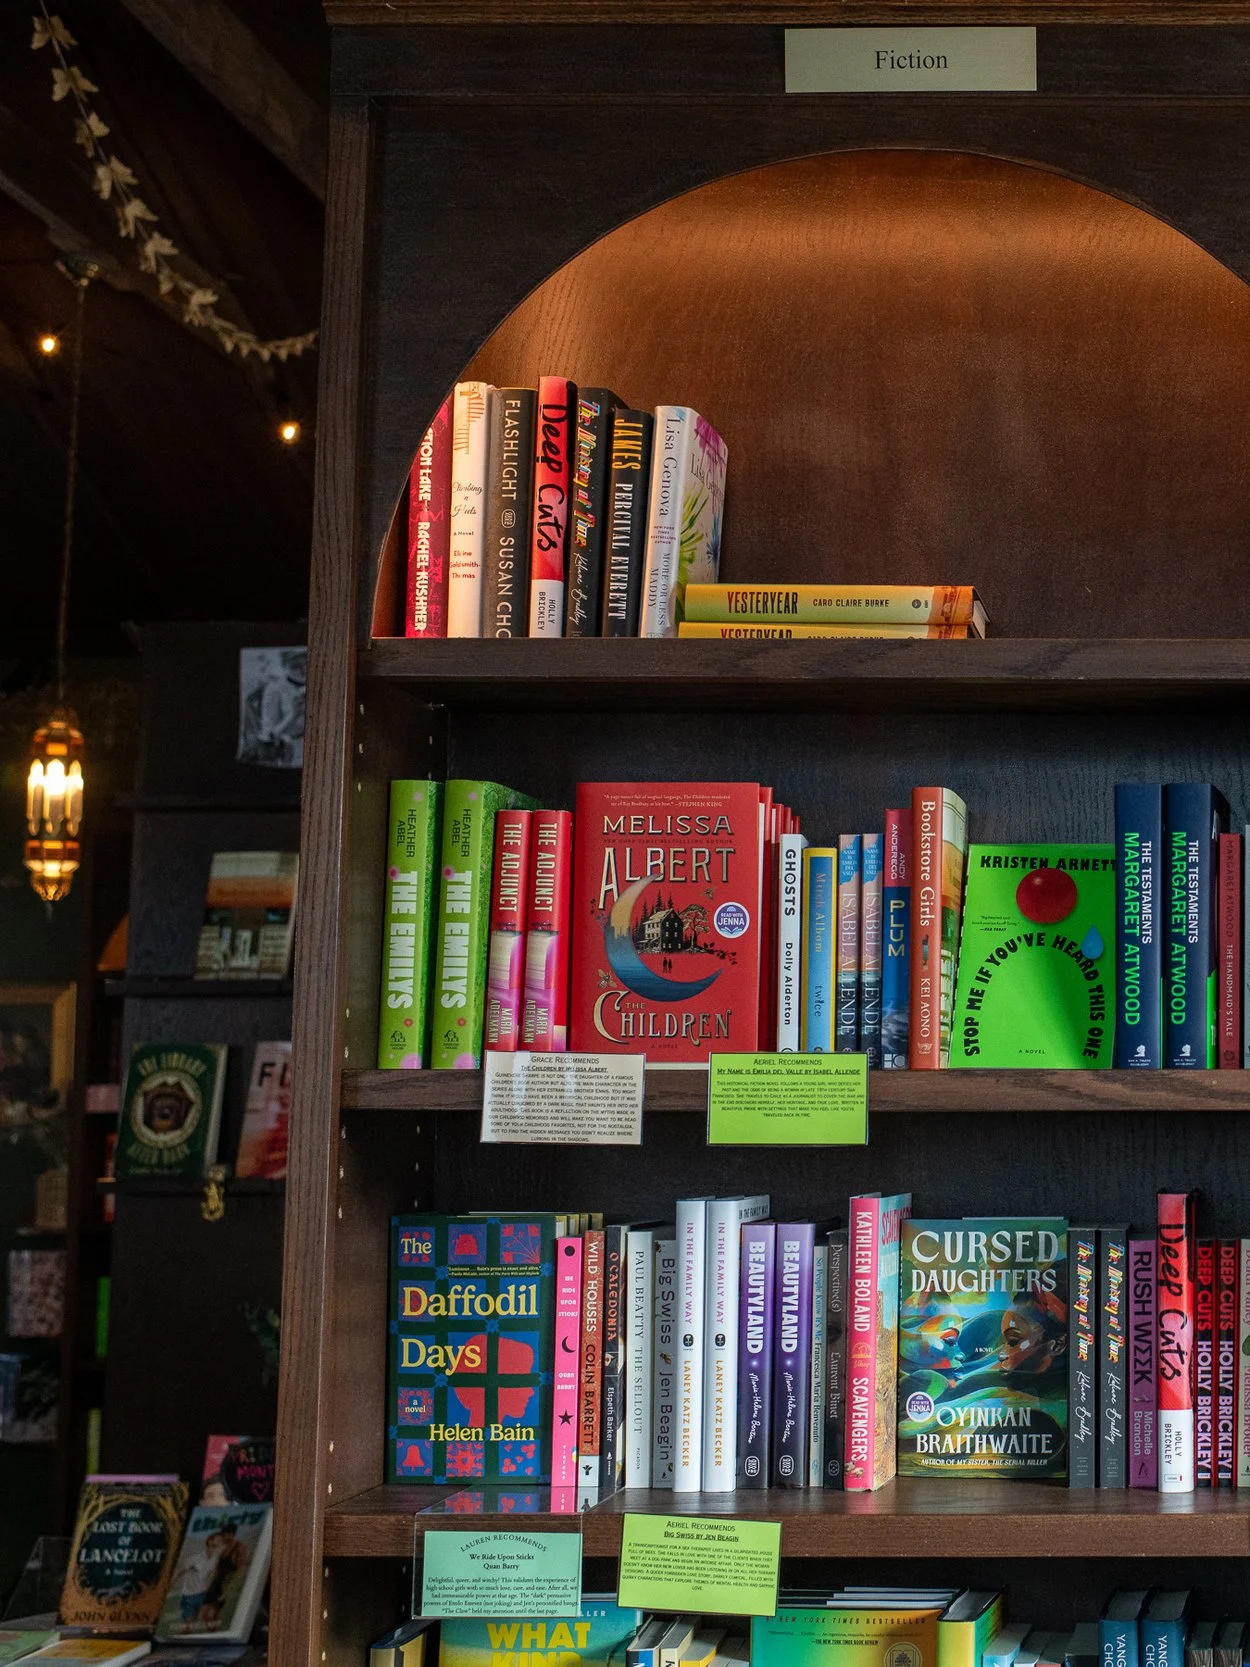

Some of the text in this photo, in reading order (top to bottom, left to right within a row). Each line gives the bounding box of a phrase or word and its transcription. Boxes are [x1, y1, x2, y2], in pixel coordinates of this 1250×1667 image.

[874, 50, 948, 69] Fiction
[501, 400, 522, 502] FLASHLIGHT
[613, 418, 644, 471] JAMES
[536, 404, 568, 552] Deep Cuts
[497, 537, 515, 597] SUSAN
[608, 483, 633, 620] PERCIVAL EVERETT
[538, 591, 547, 631] BRICKLEY
[547, 598, 555, 624] HOLLY
[727, 591, 798, 616] YESTERYEAR
[813, 597, 890, 608] CARO CLAIRE BURKE
[396, 819, 405, 846] ABEL
[407, 808, 416, 858] HEATHER
[603, 816, 734, 835] MELISSA
[499, 823, 521, 913] THE ADJUNCT
[599, 847, 736, 910] ALBERT
[784, 848, 796, 917] GHOSTS
[920, 800, 935, 927] Bookstore Girls
[980, 856, 1049, 869] KRISTEN
[1141, 841, 1152, 944] THE TESTAMENTS
[387, 871, 418, 1009] THE EMILYS
[717, 917, 745, 926] JENNA
[1124, 832, 1139, 1025] MARGARET ATWOOD
[784, 942, 793, 1026] Dolly Alderton
[964, 932, 1105, 1060] STOP ME IF YOU'VE HEARD THIS ONE
[488, 999, 500, 1043] ADELMANN
[499, 1008, 513, 1034] MARIA
[593, 990, 732, 1045] CHILDREN
[401, 1238, 432, 1254] The
[911, 1230, 1058, 1264] CURSED
[853, 1211, 873, 1332] KATHLEEN BOLAND
[911, 1269, 1058, 1293] DAUGHTERS
[1196, 1247, 1211, 1330] DEEP CUTS
[403, 1285, 539, 1317] Daffodil
[659, 1258, 675, 1344] Big Swiss
[746, 1242, 766, 1354] BEAUTYLAND
[401, 1338, 481, 1376] Days
[584, 1344, 596, 1447] COLIN BARRETT
[658, 1372, 673, 1460] Jen Beagin
[936, 1406, 1031, 1427] OYINKAN
[1197, 1341, 1211, 1470] HOLLY BRICKLEY
[430, 1423, 534, 1441] Helen Bain
[851, 1377, 868, 1462] SCAVENGERS
[1133, 1411, 1142, 1456] Brandon
[1143, 1411, 1152, 1455] Michelle
[714, 1427, 722, 1467] BECKER
[916, 1434, 1052, 1455] BRAITHWAITE
[93, 1521, 162, 1533] LOST BOOK
[461, 1534, 547, 1552] LAUREN RECOMMENDS
[691, 1522, 735, 1531] RECOMMENDS
[79, 1548, 163, 1563] LANCELOT
[502, 1563, 519, 1571] Barry
[72, 1611, 105, 1621] JOHN
[487, 1623, 591, 1649] WHAT
